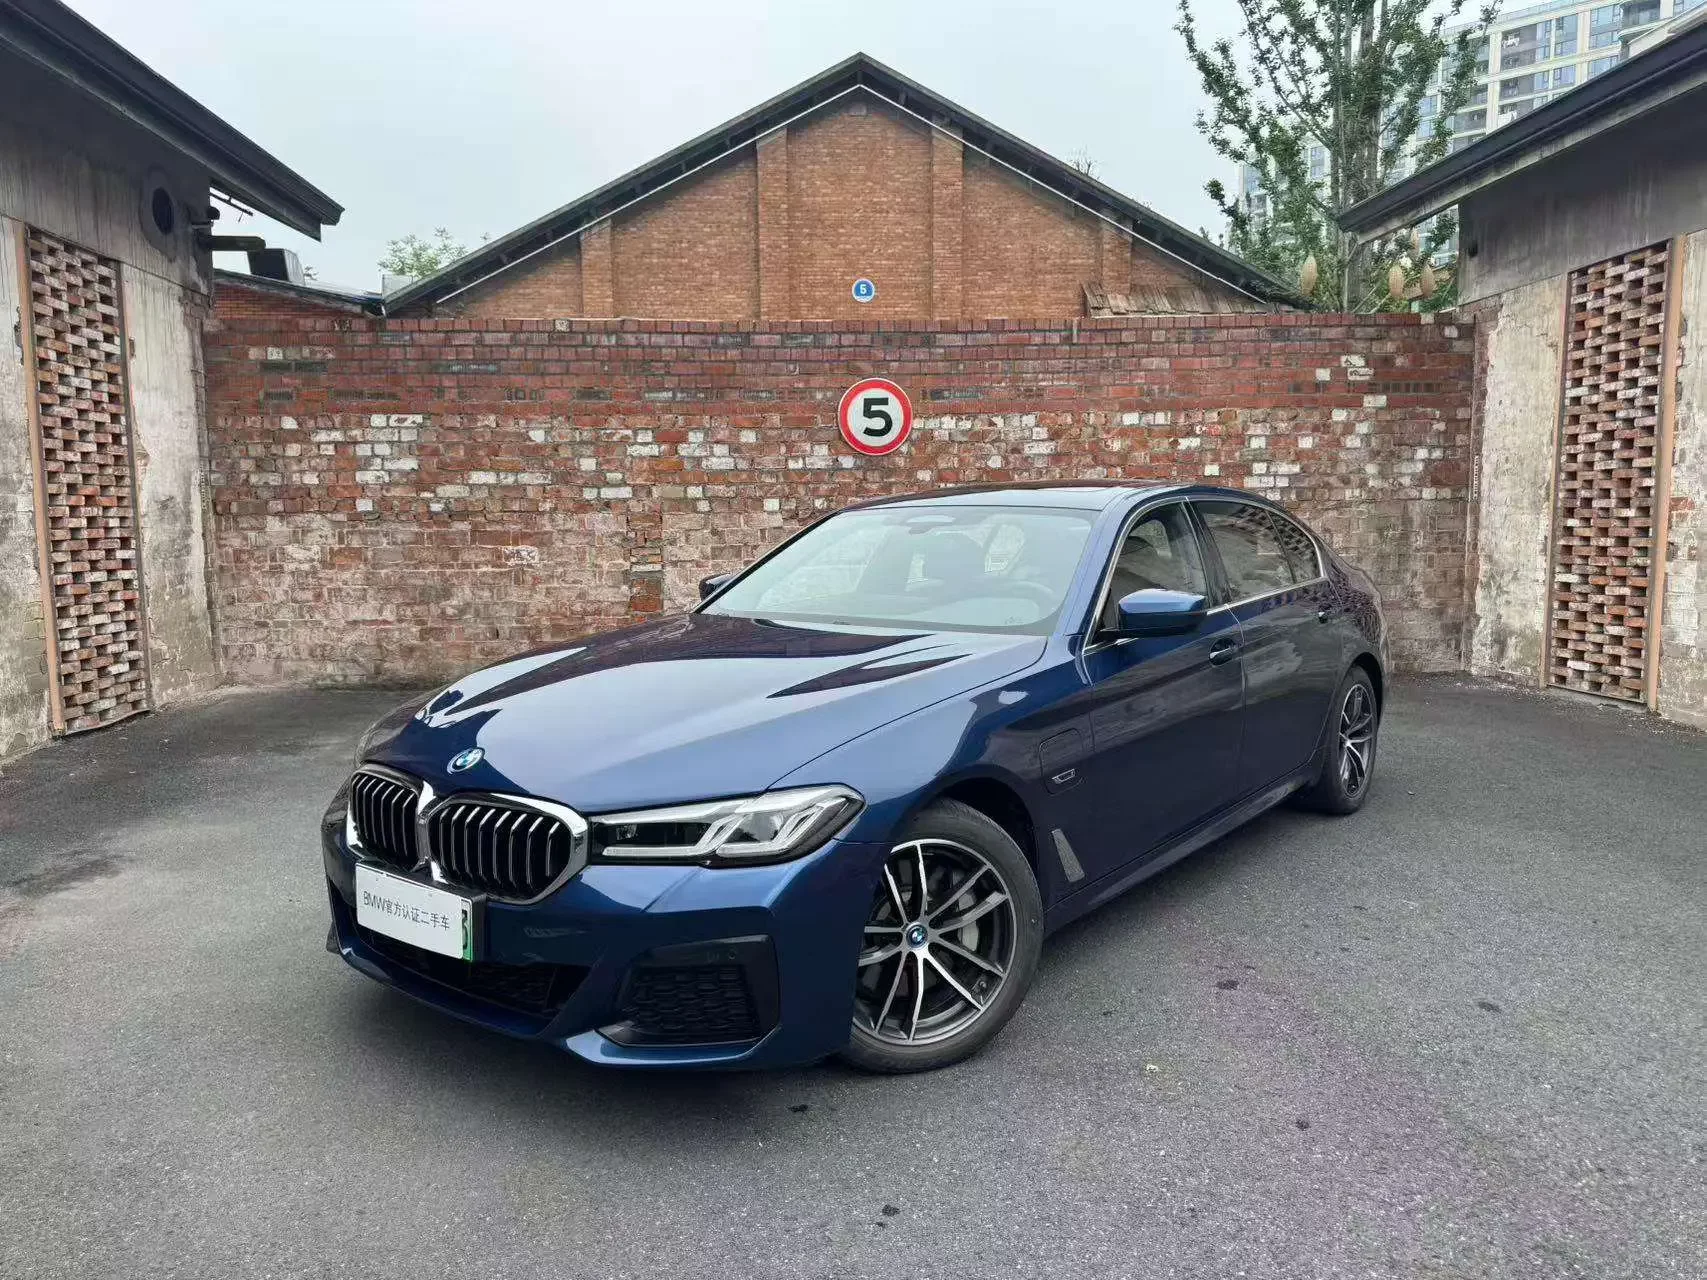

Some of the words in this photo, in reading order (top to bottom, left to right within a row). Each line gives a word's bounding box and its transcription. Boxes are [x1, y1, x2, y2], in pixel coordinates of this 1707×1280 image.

[863, 397, 893, 437] 5
[363, 890, 450, 931] BMW官方认证二手车
